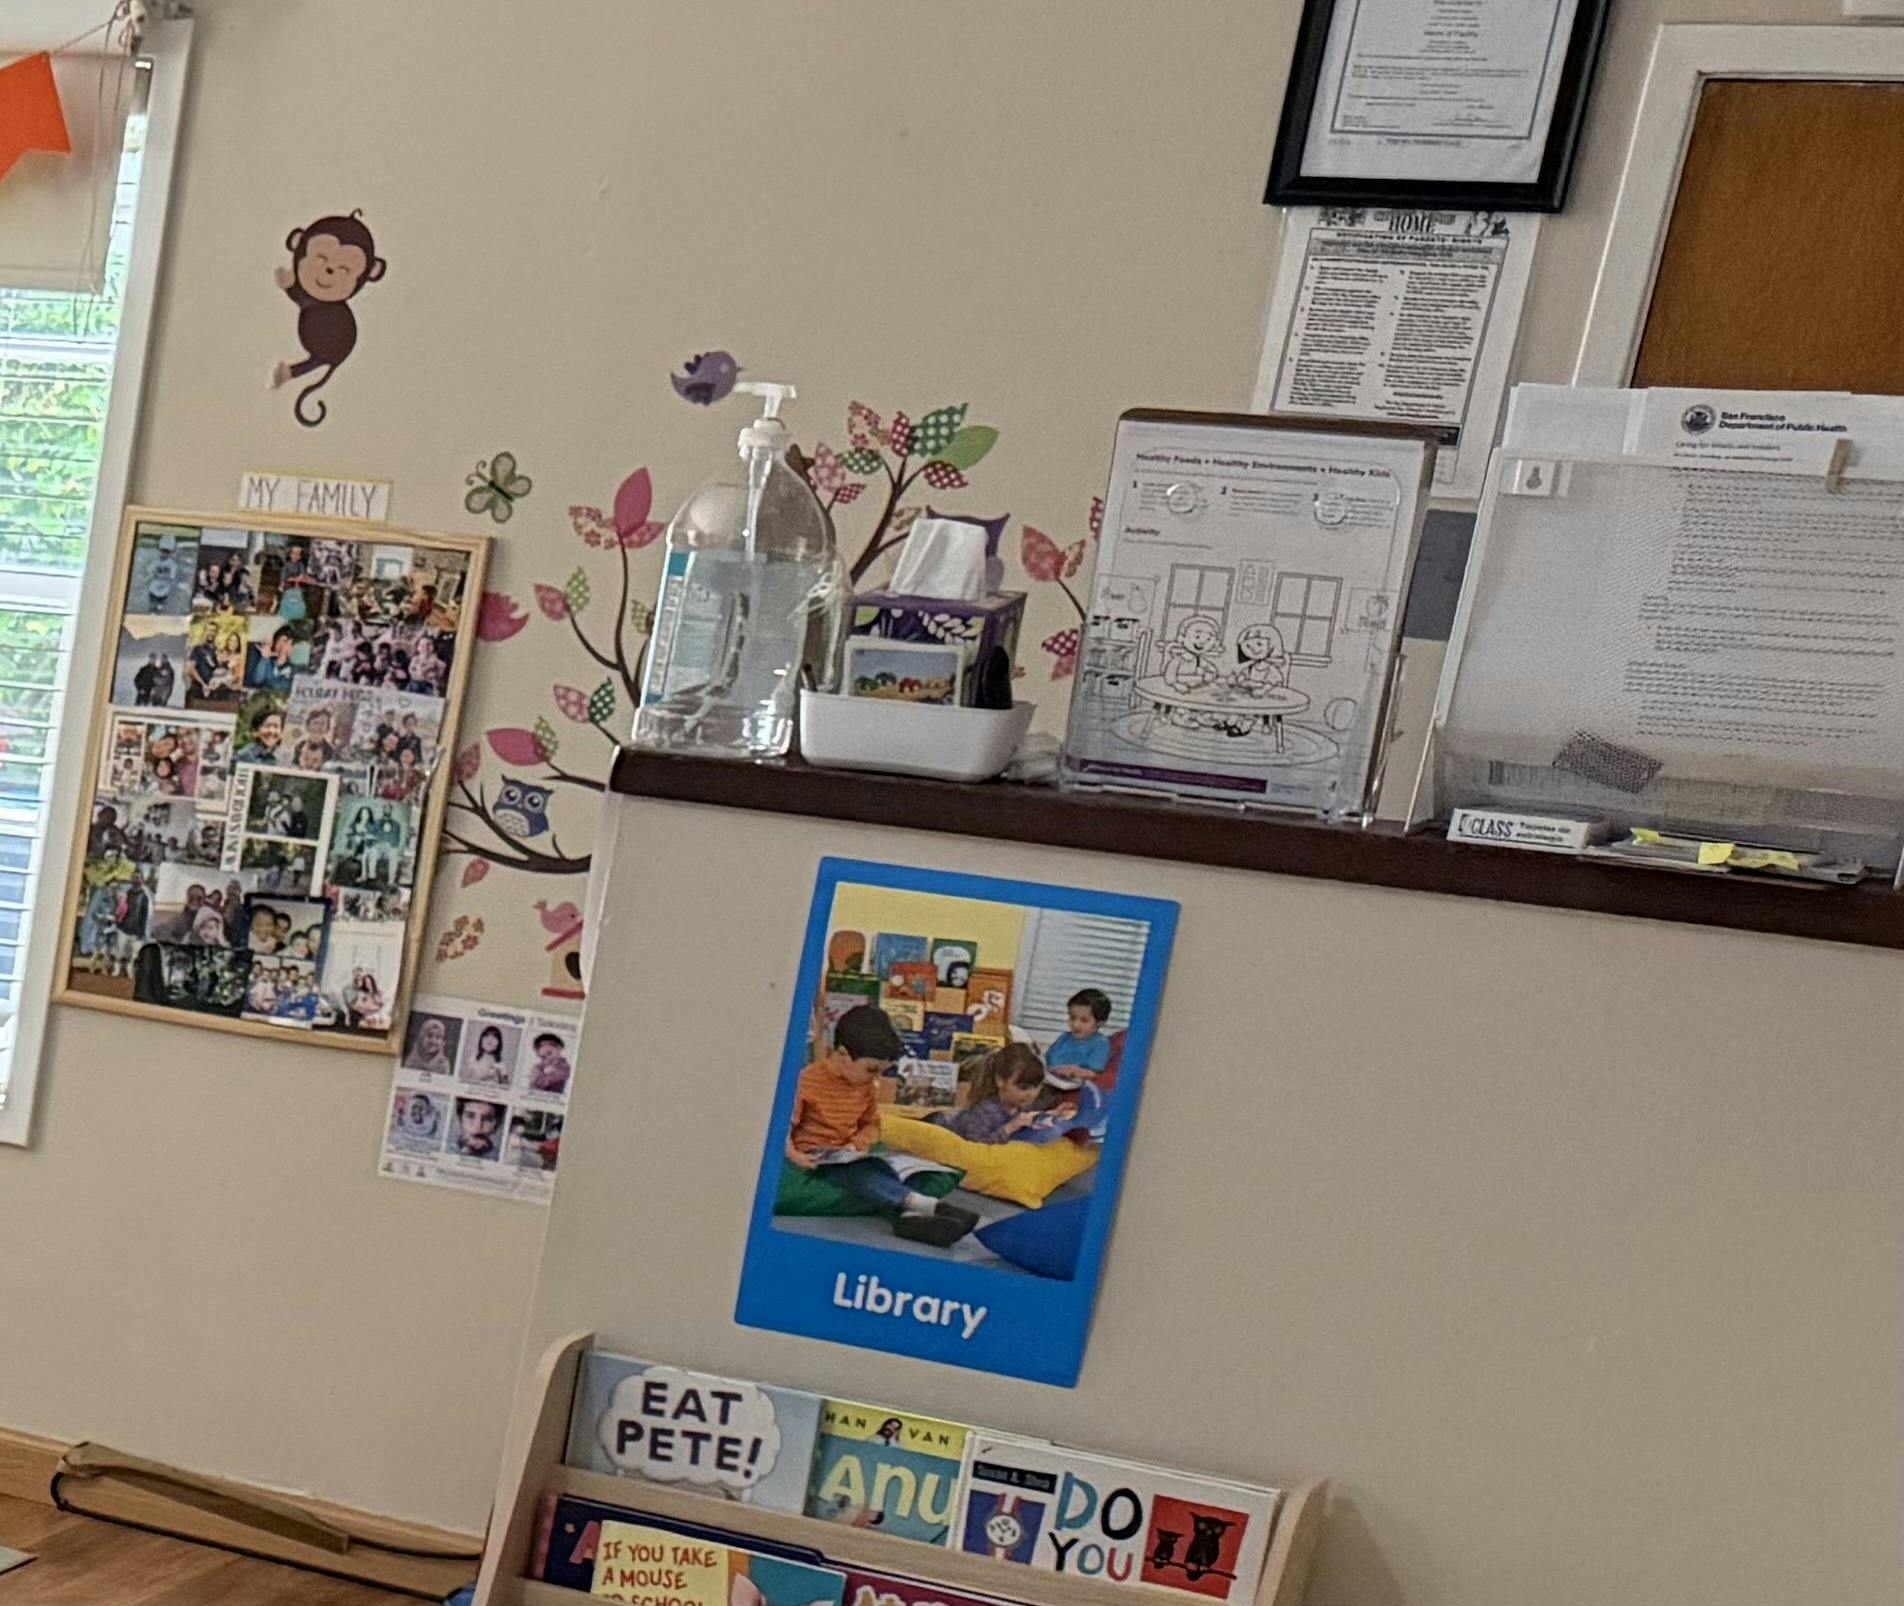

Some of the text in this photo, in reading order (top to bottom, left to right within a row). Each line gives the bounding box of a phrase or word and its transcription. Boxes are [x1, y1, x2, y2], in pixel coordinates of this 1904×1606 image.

[247, 476, 377, 521] MY FAMILY
[833, 1271, 988, 1340] Library
[641, 1381, 743, 1426] EAT
[616, 1419, 763, 1479] PETE!
[908, 1427, 951, 1446] VAN
[1055, 1470, 1143, 1541] DO
[602, 1540, 718, 1568] IF YOU TAKE
[1048, 1531, 1133, 1582] YOU
[601, 1566, 688, 1590] A MOUSE
